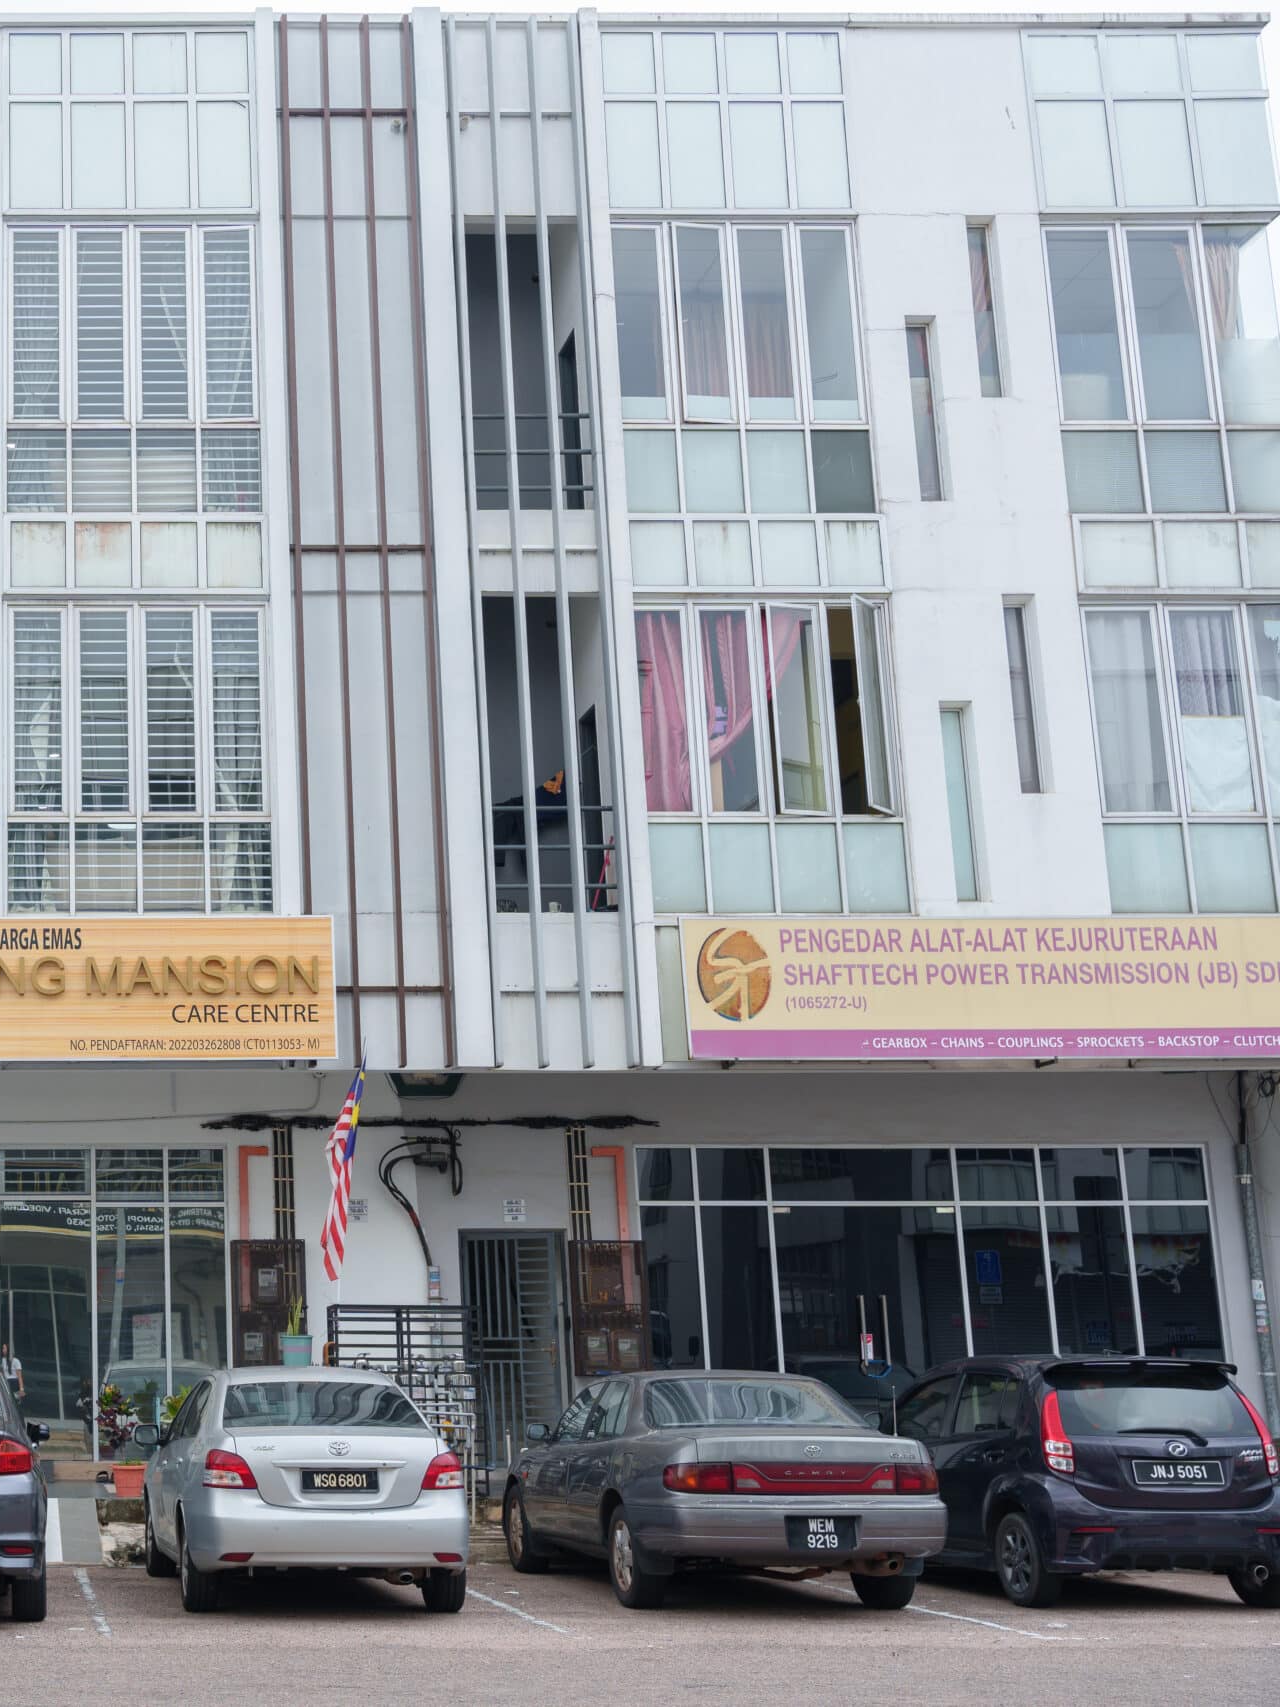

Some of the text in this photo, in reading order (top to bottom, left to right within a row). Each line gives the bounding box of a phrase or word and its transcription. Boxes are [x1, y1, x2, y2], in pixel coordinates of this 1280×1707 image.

[43, 928, 81, 949] EMAS
[780, 927, 1217, 953] PENGEDAR ALAT-ALAT KEJURUTERAAN
[86, 956, 320, 995] MANSION
[784, 960, 1280, 988] SHAFTTECH POWER TRANSMISSION (JB) SD
[785, 996, 867, 1012] (1065272-U)
[172, 1004, 319, 1023] CARE CENTRE
[71, 1040, 87, 1050] NO.
[91, 1040, 166, 1050] PENDAFTARAN:
[169, 1039, 240, 1050] 202203262808
[872, 1035, 1280, 1048] GEARBOX CHAINS COUPLINGS SPROCKETS BACKSTOP CLUTCH
[1151, 1465, 1207, 1478] JNJ 5051
[314, 1474, 367, 1487] WSQ 6801
[808, 1519, 834, 1533] WEM
[808, 1535, 838, 1548] 9219
